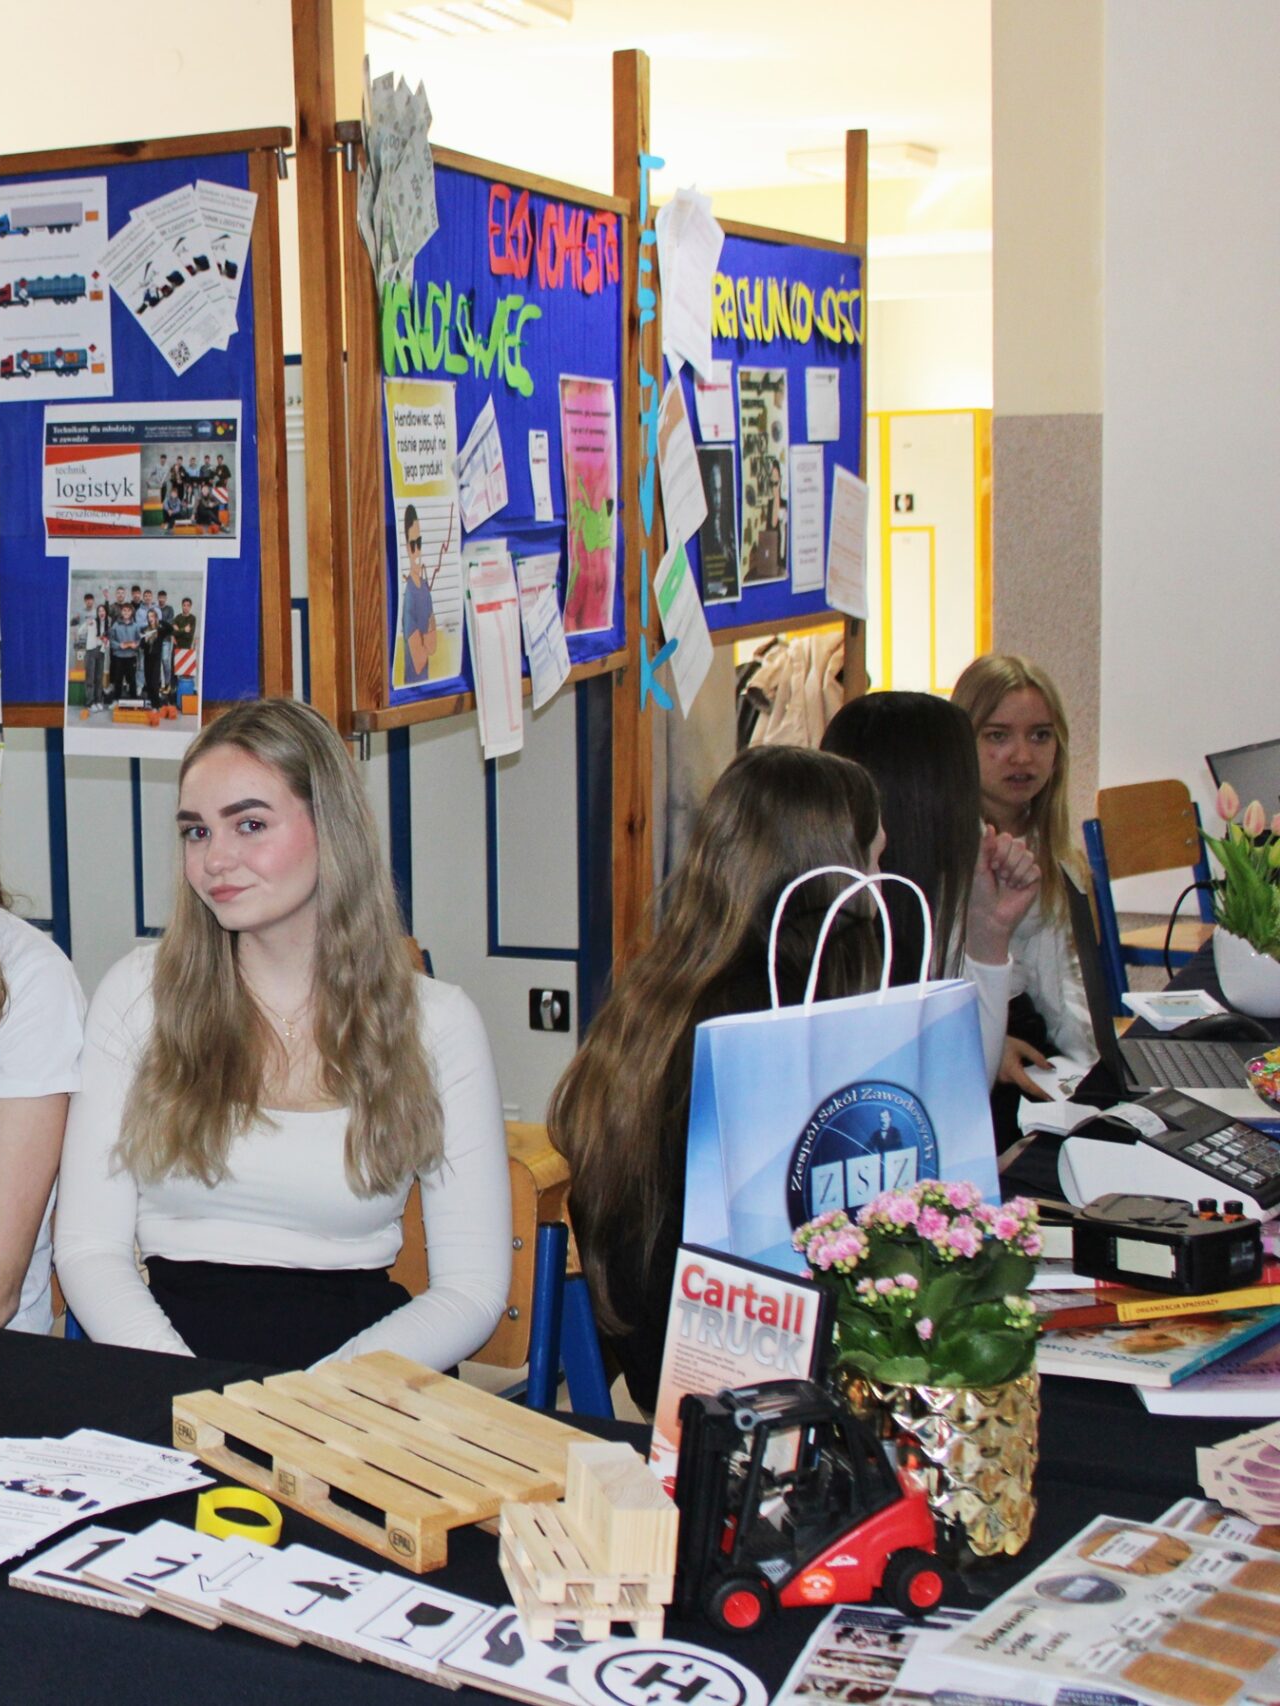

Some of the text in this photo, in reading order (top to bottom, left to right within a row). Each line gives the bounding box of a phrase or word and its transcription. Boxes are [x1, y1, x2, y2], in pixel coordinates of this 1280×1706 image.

[488, 183, 619, 295] EKONOMISTA
[55, 465, 87, 475] technik
[56, 476, 135, 503] logistyk
[791, 1088, 934, 1191] Zespół Szkół Zawodowych
[680, 1264, 806, 1335] Cartall
[676, 1300, 808, 1377] TRUCK
[177, 1425, 195, 1443] EPAL
[392, 1531, 412, 1551] EPAL
[631, 1662, 711, 1704] H
